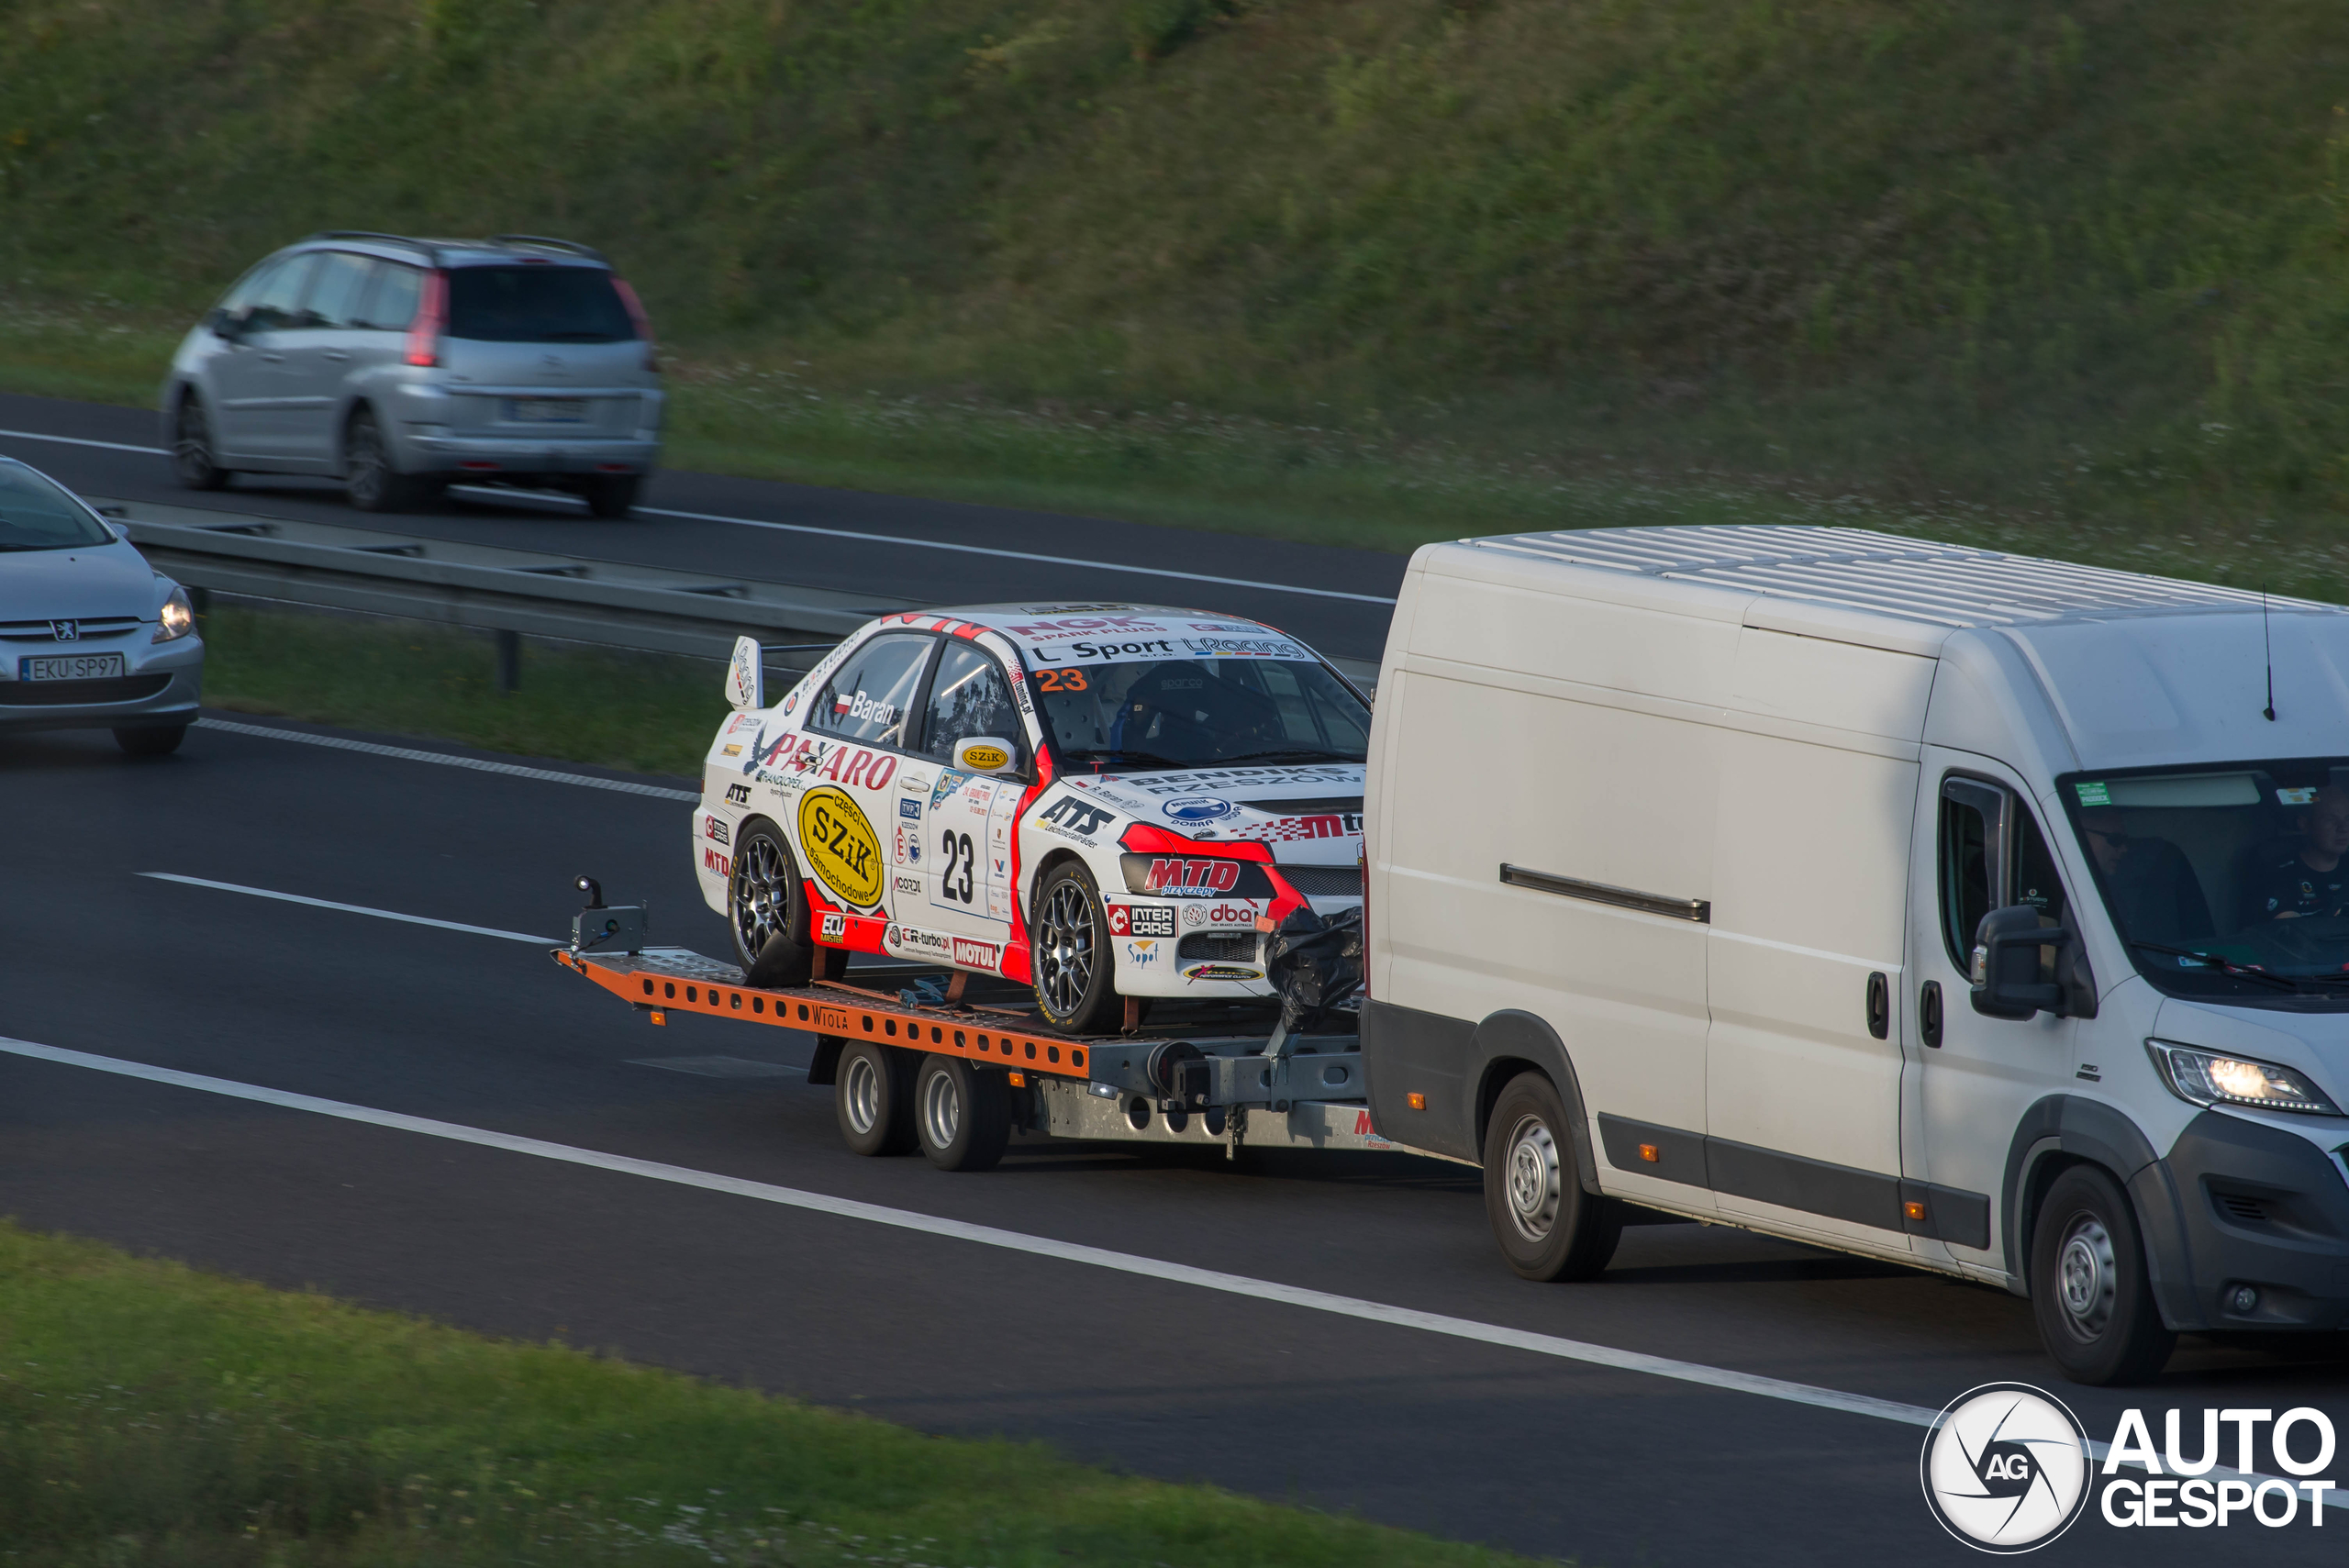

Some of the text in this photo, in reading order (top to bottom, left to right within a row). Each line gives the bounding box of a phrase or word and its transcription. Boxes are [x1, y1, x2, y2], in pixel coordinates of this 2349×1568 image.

[1004, 616, 1156, 636] NGK
[1030, 627, 1168, 641] SPARK PLUGS
[1032, 639, 1174, 662] L Sport
[34, 658, 118, 679] EKU SP97
[1035, 668, 1088, 692] 23
[1161, 678, 1203, 688] sparco
[850, 690, 895, 725] Baran
[1128, 767, 1350, 786] BENDIKS
[1147, 773, 1362, 795] RZESZÓW
[725, 783, 752, 803] ATS
[1098, 790, 1123, 804] Baran
[834, 795, 861, 826] części
[914, 803, 920, 817] 3
[1040, 795, 1117, 836] ATS
[1171, 818, 1214, 828] DOBRA
[812, 806, 872, 883] SZiK
[705, 846, 729, 878] MTD
[942, 828, 974, 904] 23
[809, 847, 870, 902] samochodowe
[1144, 859, 1241, 892] MTD
[1161, 884, 1219, 897] przyczepy
[1131, 907, 1173, 922] INTER
[1210, 904, 1252, 923] dba
[821, 915, 846, 936] ECU
[1131, 921, 1174, 935] CARS
[820, 933, 844, 944] MASTER
[902, 928, 950, 951] CR-turbo.pl
[955, 941, 995, 968] MOTUL
[1128, 942, 1160, 970] Sopot
